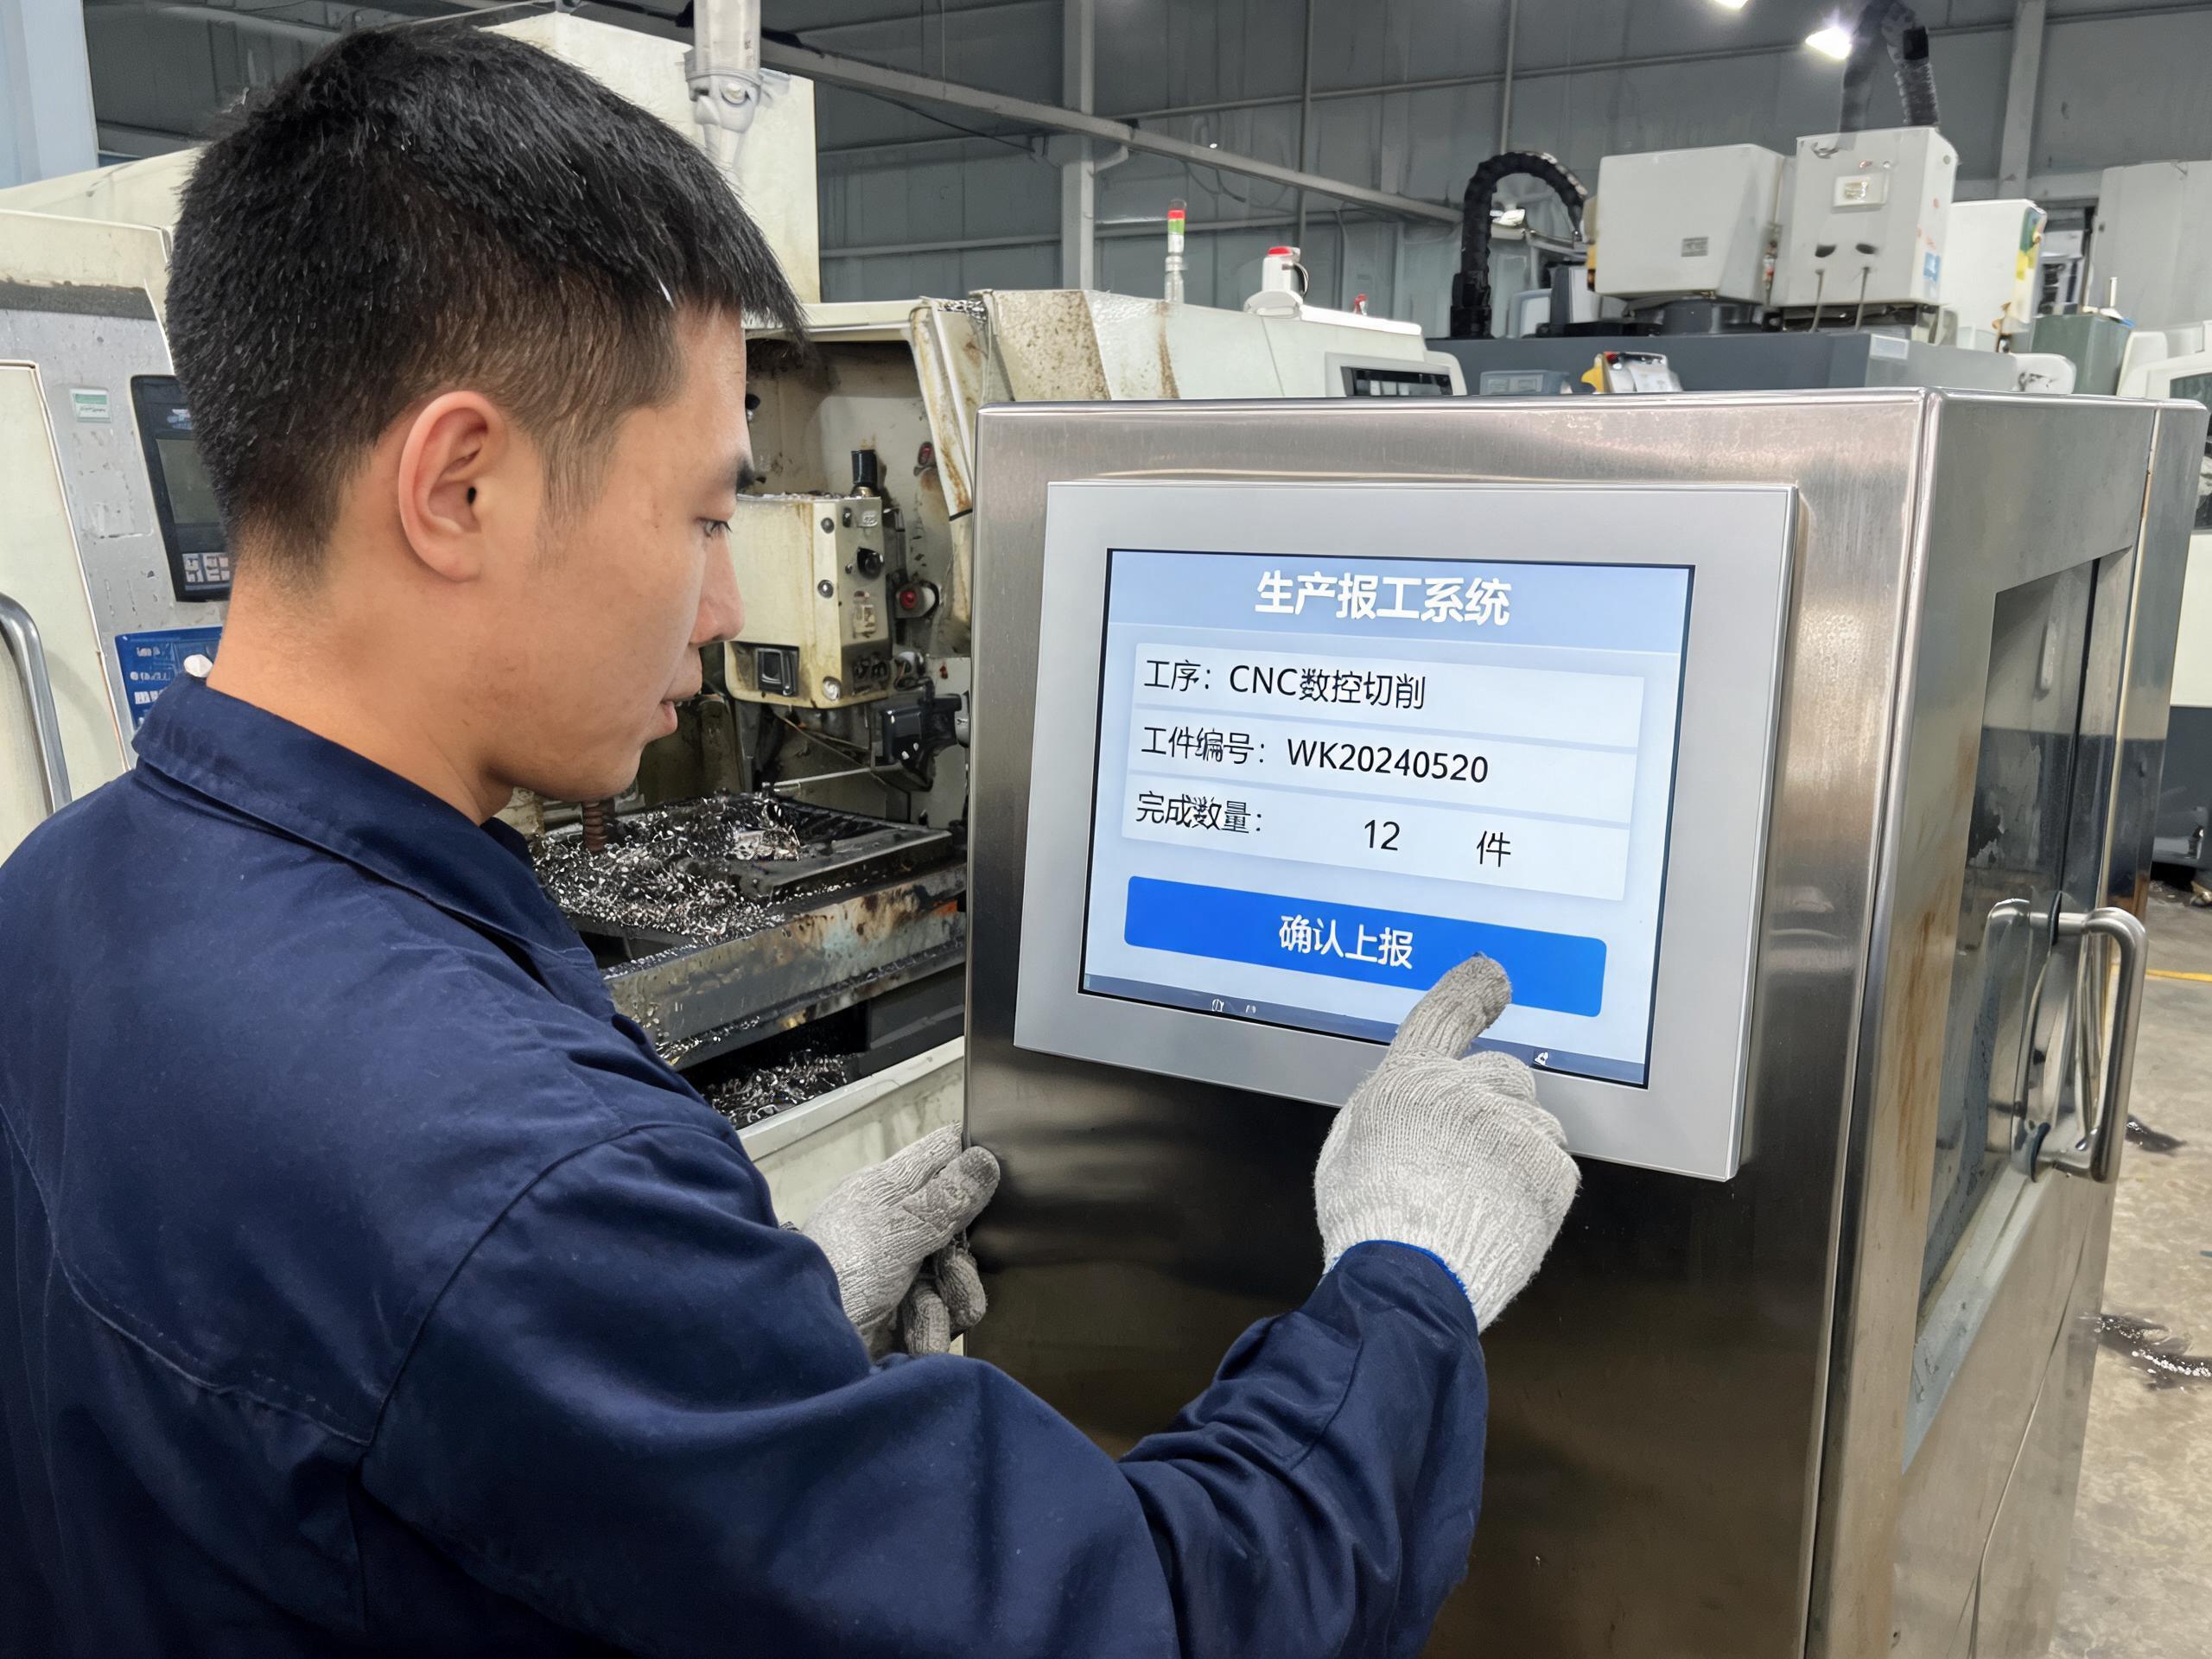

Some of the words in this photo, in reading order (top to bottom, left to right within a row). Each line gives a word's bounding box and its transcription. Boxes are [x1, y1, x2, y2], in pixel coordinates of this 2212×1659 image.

[1255, 570, 1512, 626] 生产报工系统
[1230, 664, 1426, 710] CNC数控切削
[1287, 738, 1489, 784] WK20240520
[1364, 819, 1400, 851] 12
[1476, 830, 1511, 868] 件
[1279, 914, 1413, 969] 确认上报
